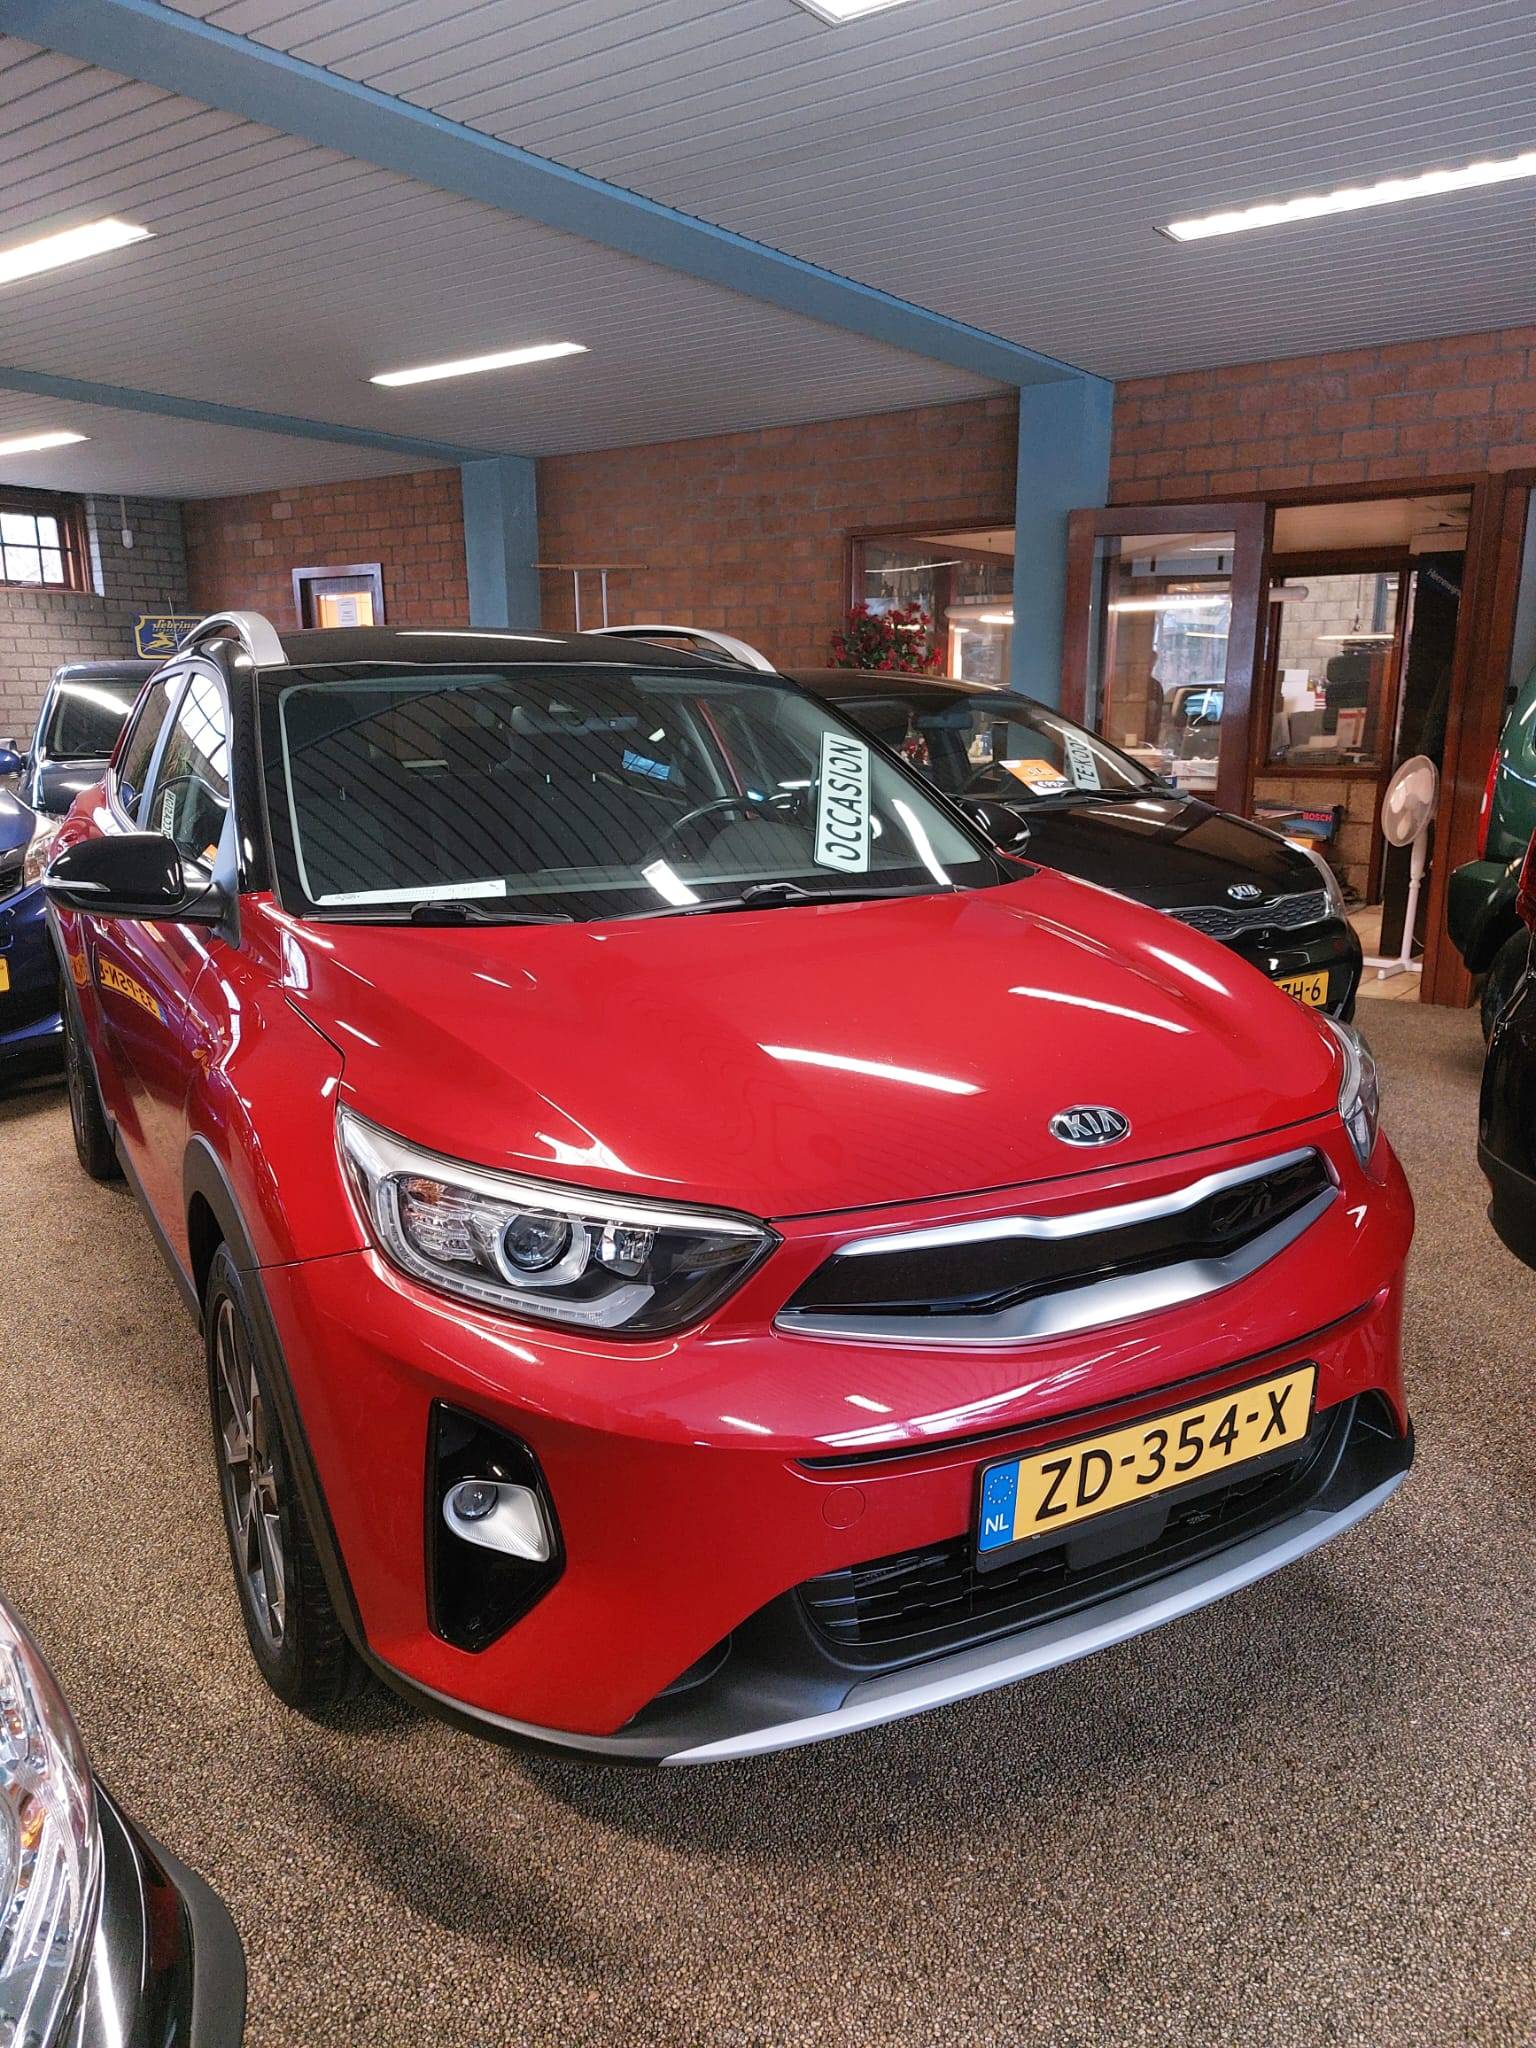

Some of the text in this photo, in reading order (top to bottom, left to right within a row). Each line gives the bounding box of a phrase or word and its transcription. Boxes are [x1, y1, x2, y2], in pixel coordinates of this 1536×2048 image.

[825, 740, 862, 861] OCCASION
[1301, 811, 1333, 822] BOSCH
[1234, 885, 1259, 897] KIA
[1060, 1108, 1124, 1140] KIA
[1035, 1384, 1293, 1522] ZD-354-X
[984, 1514, 1010, 1536] NL
